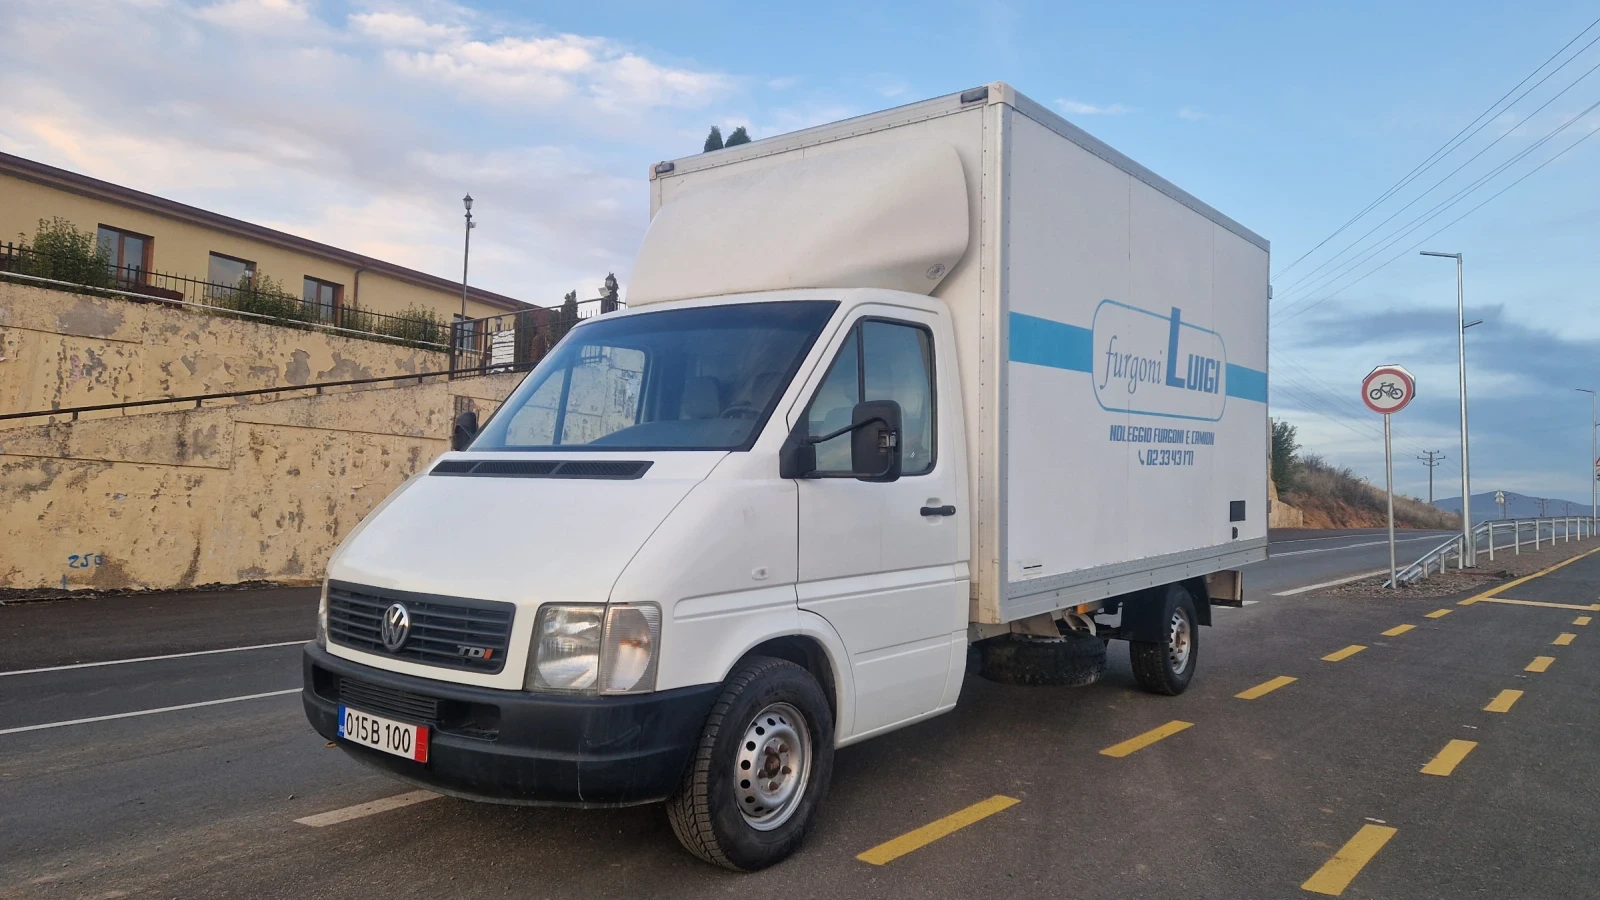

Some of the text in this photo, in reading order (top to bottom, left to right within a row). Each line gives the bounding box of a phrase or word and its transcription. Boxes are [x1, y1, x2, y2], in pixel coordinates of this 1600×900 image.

[1099, 306, 1221, 394] furgoni LUIGI
[1109, 424, 1215, 446] NOLEGGIO FURGONI E CAMION
[457, 644, 494, 660] TDI
[385, 723, 411, 754] 100
